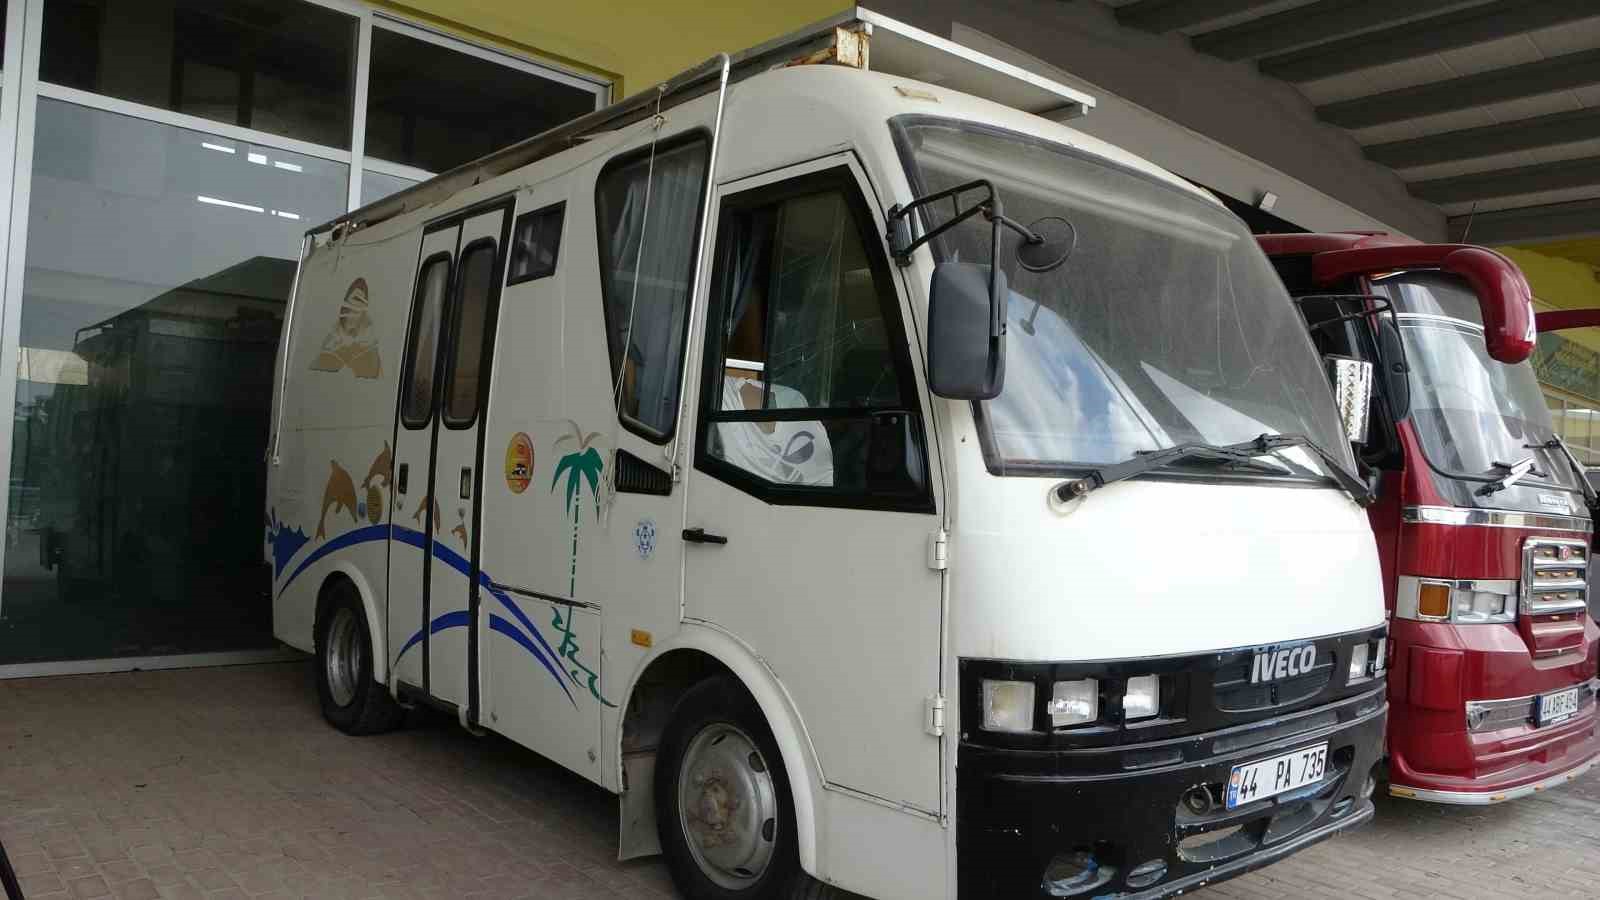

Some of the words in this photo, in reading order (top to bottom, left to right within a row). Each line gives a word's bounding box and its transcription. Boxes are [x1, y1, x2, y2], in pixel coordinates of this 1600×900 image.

[1251, 644, 1317, 684] IVECO
[1240, 767, 1258, 799] 44
[1274, 759, 1291, 791] PA
[1300, 750, 1325, 783] 735
